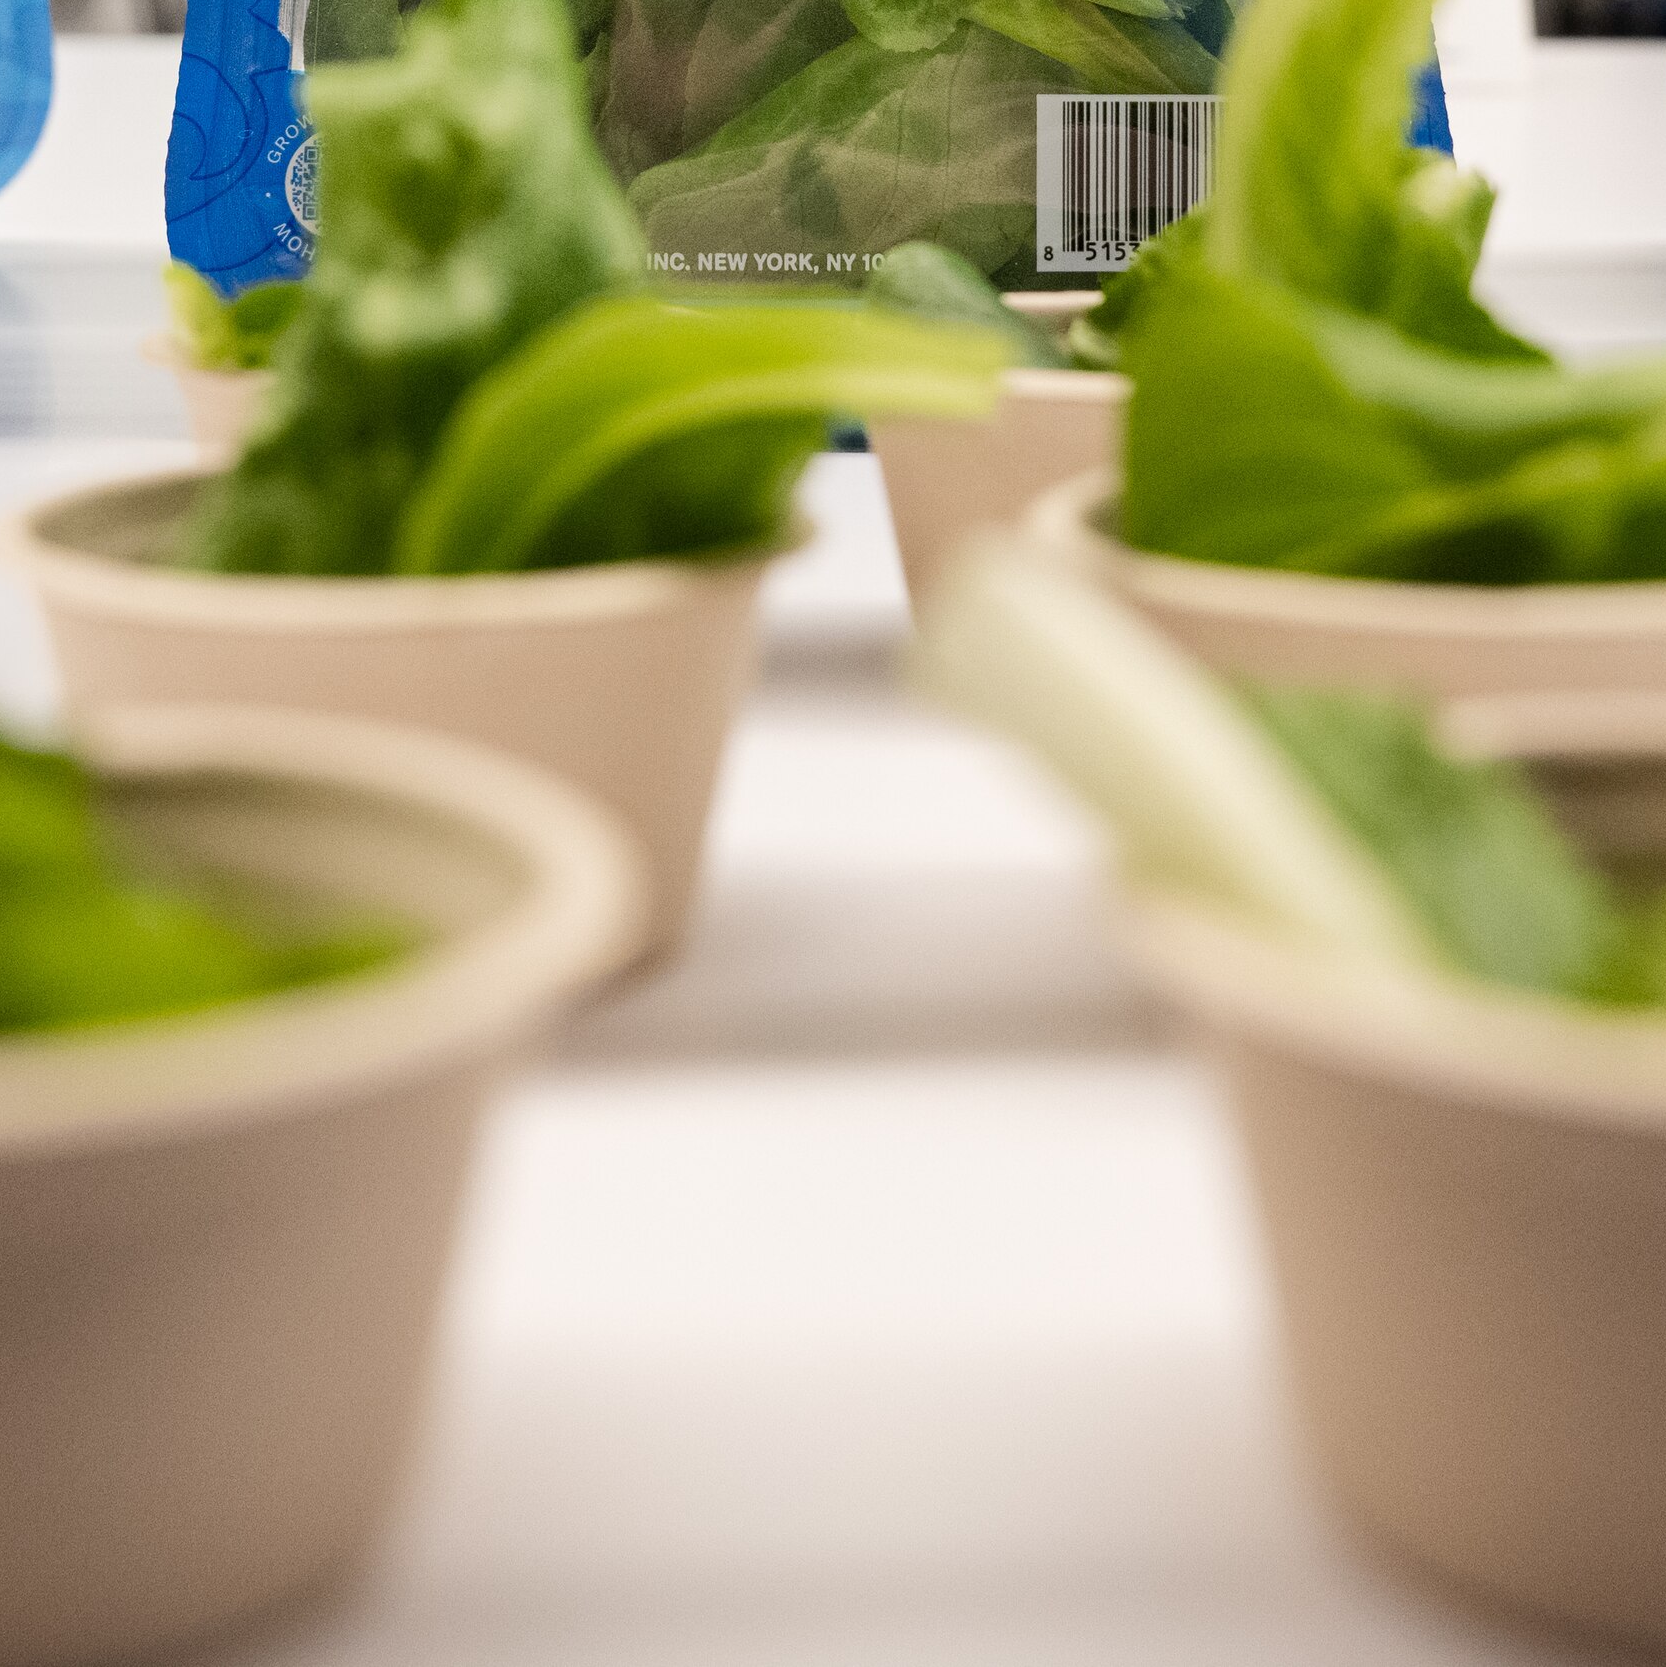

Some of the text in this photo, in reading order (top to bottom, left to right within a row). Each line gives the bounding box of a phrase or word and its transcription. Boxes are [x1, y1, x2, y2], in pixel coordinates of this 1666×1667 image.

[267, 112, 315, 164] GROW
[273, 222, 316, 261] HOW
[1044, 245, 1054, 261] 8
[646, 253, 690, 272] INC.
[698, 253, 747, 272] NEW
[753, 253, 819, 274] YORK,
[826, 253, 857, 272] NY
